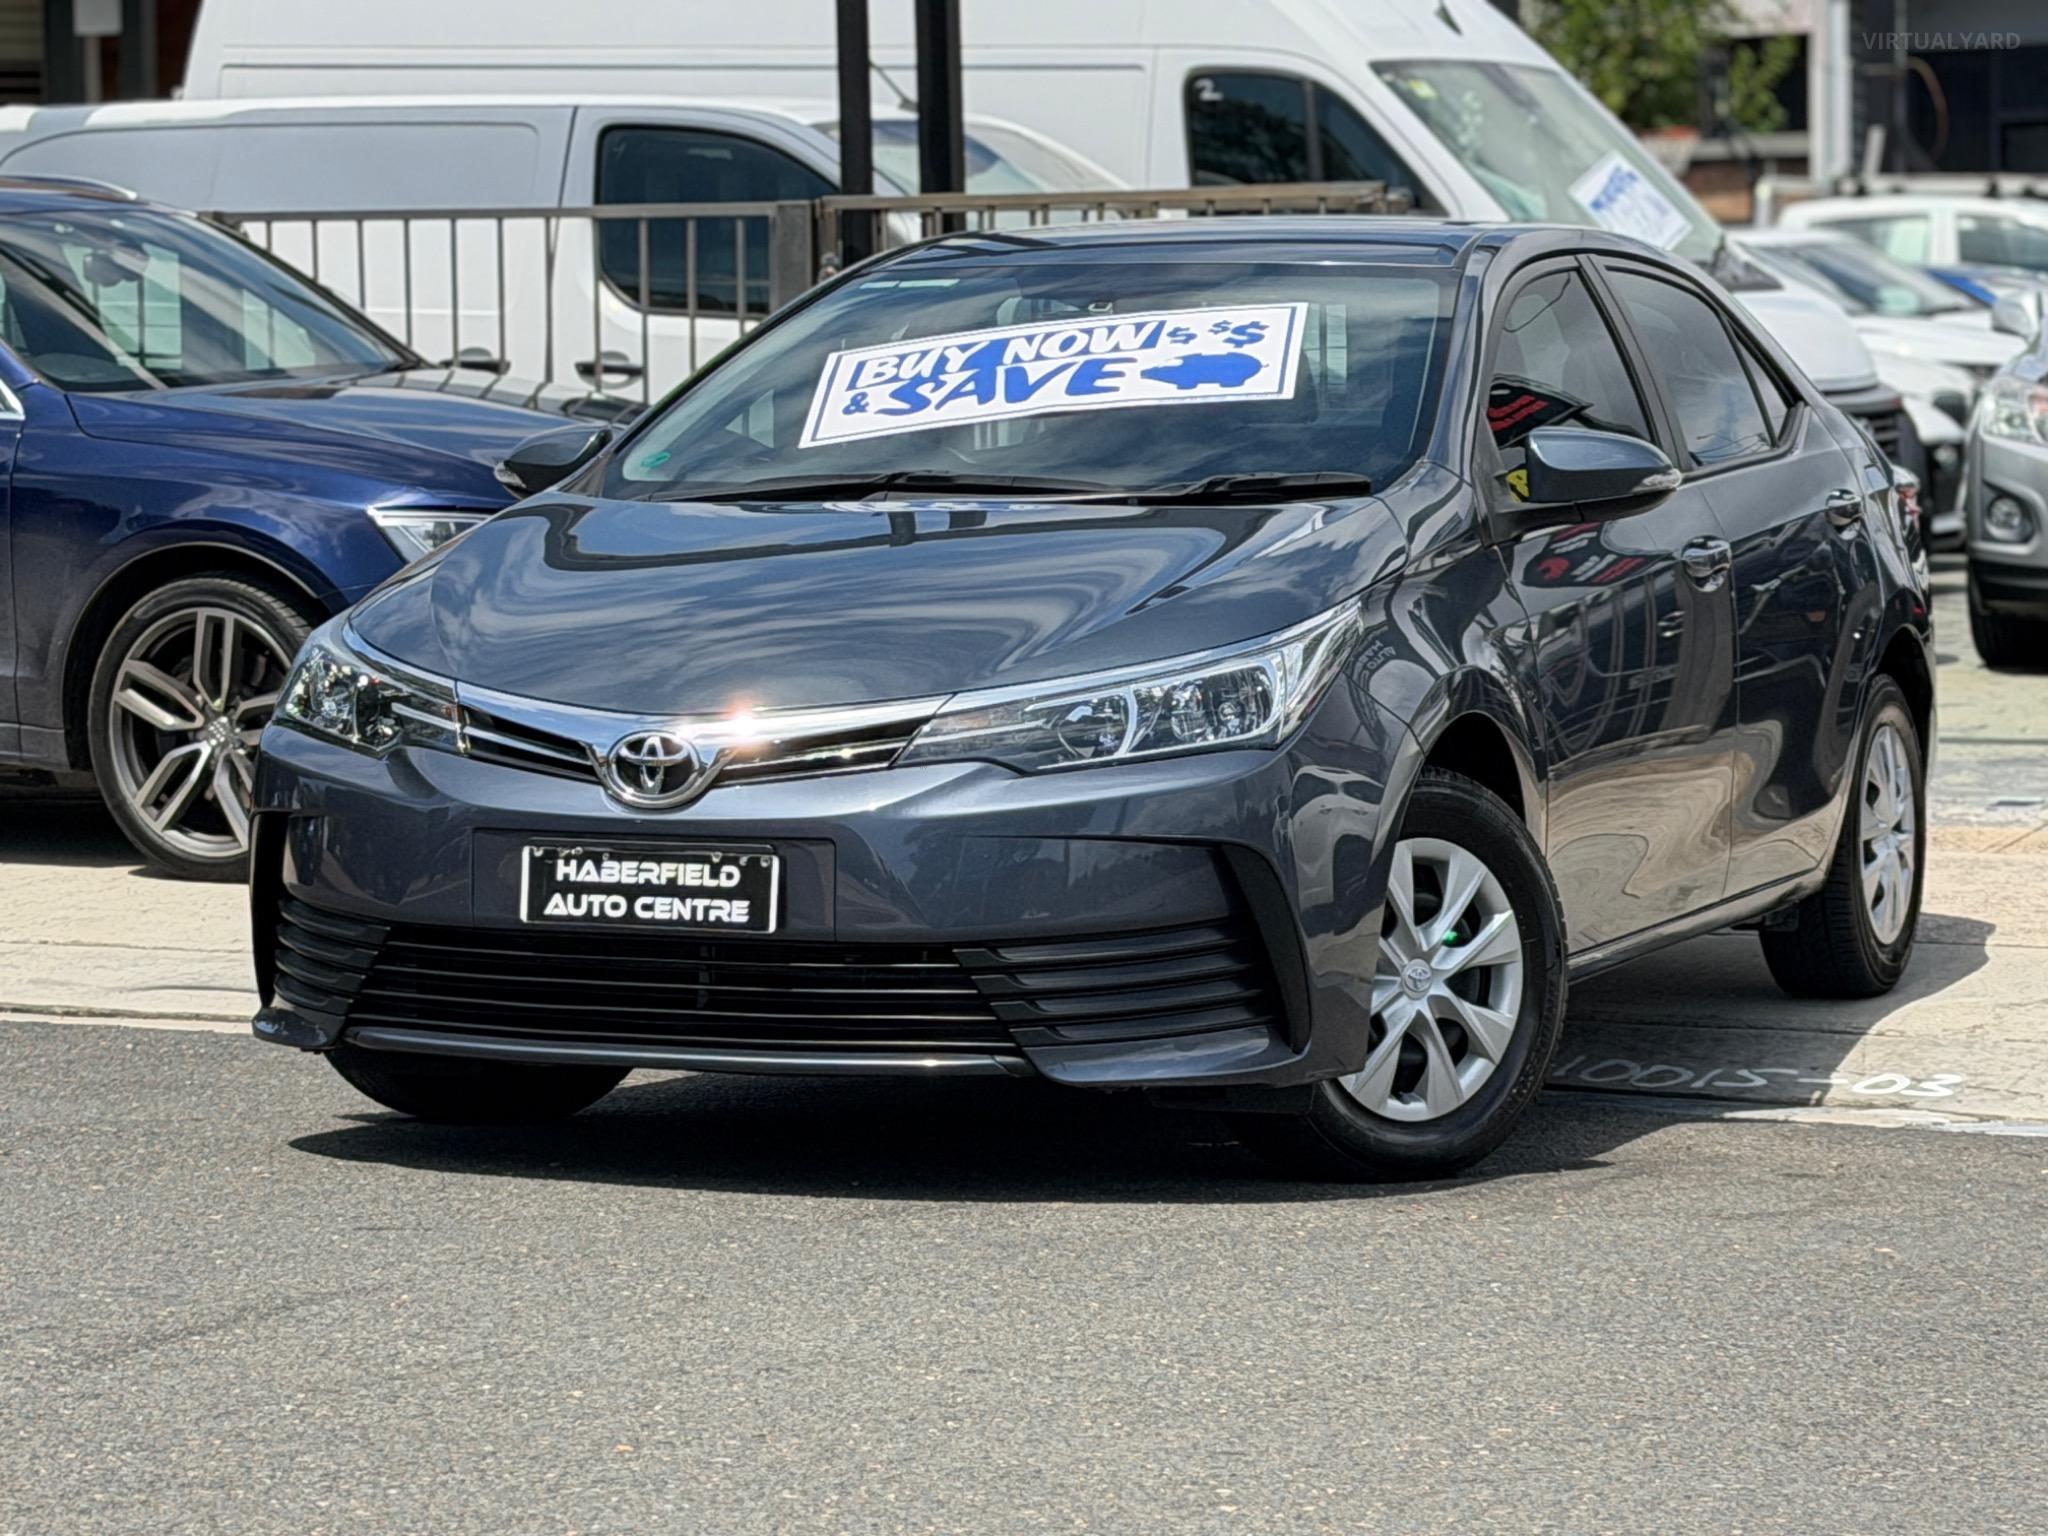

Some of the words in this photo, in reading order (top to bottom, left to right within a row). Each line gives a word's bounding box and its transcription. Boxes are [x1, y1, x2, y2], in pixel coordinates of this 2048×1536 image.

[856, 341, 990, 387] BUY
[1002, 321, 1159, 363] NOW
[842, 392, 869, 415] &
[875, 358, 1141, 416] SAVE
[556, 859, 741, 887] HABERFIELD
[543, 893, 627, 918] AUTO
[634, 896, 750, 923] CENTRE
